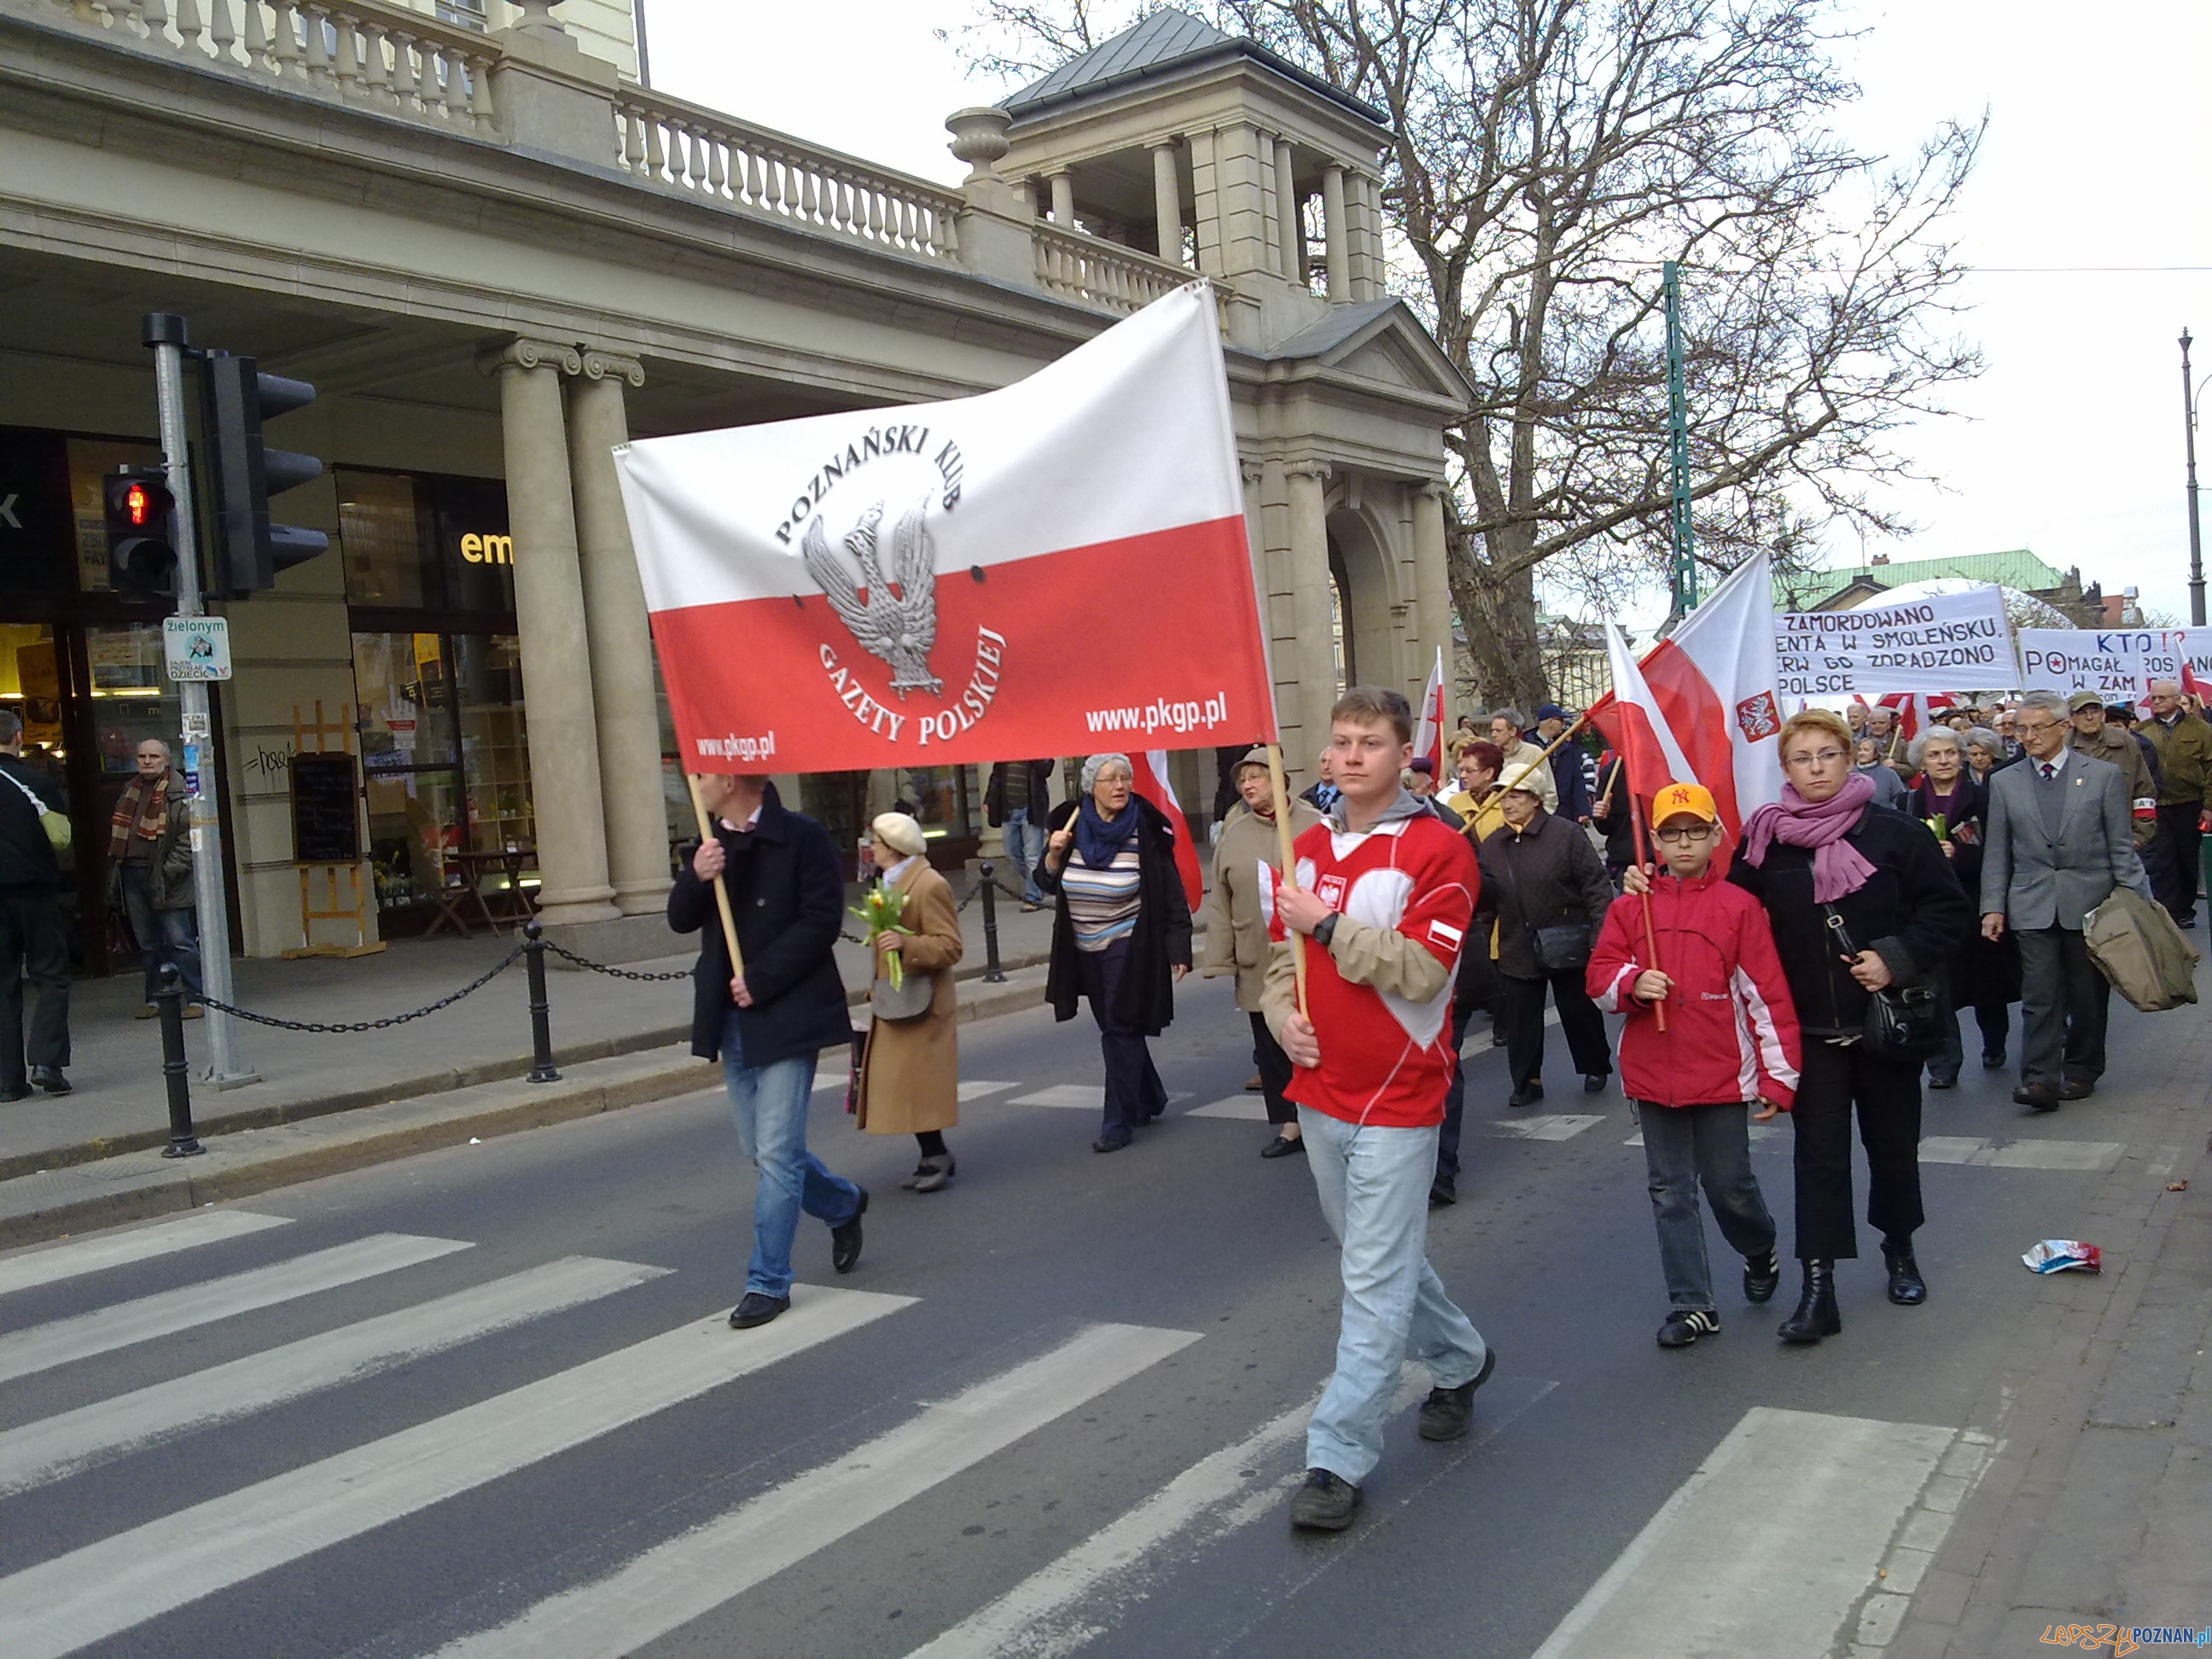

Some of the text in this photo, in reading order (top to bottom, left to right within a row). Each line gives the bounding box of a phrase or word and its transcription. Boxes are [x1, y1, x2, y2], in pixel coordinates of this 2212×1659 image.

[775, 425, 964, 544] POZNAŃSKI KLUB
[1784, 605, 1935, 632] ZAMORDOWANO
[1824, 656, 1854, 671] GO
[1866, 643, 1994, 669] ZDRADZONO
[1842, 634, 1857, 651] W
[819, 626, 1008, 745] GAZETY POLSKIEJ
[2072, 674, 2085, 690] W
[1086, 691, 1228, 735] www.pkgp.pl
[696, 730, 776, 761] www.pkgp.pl
